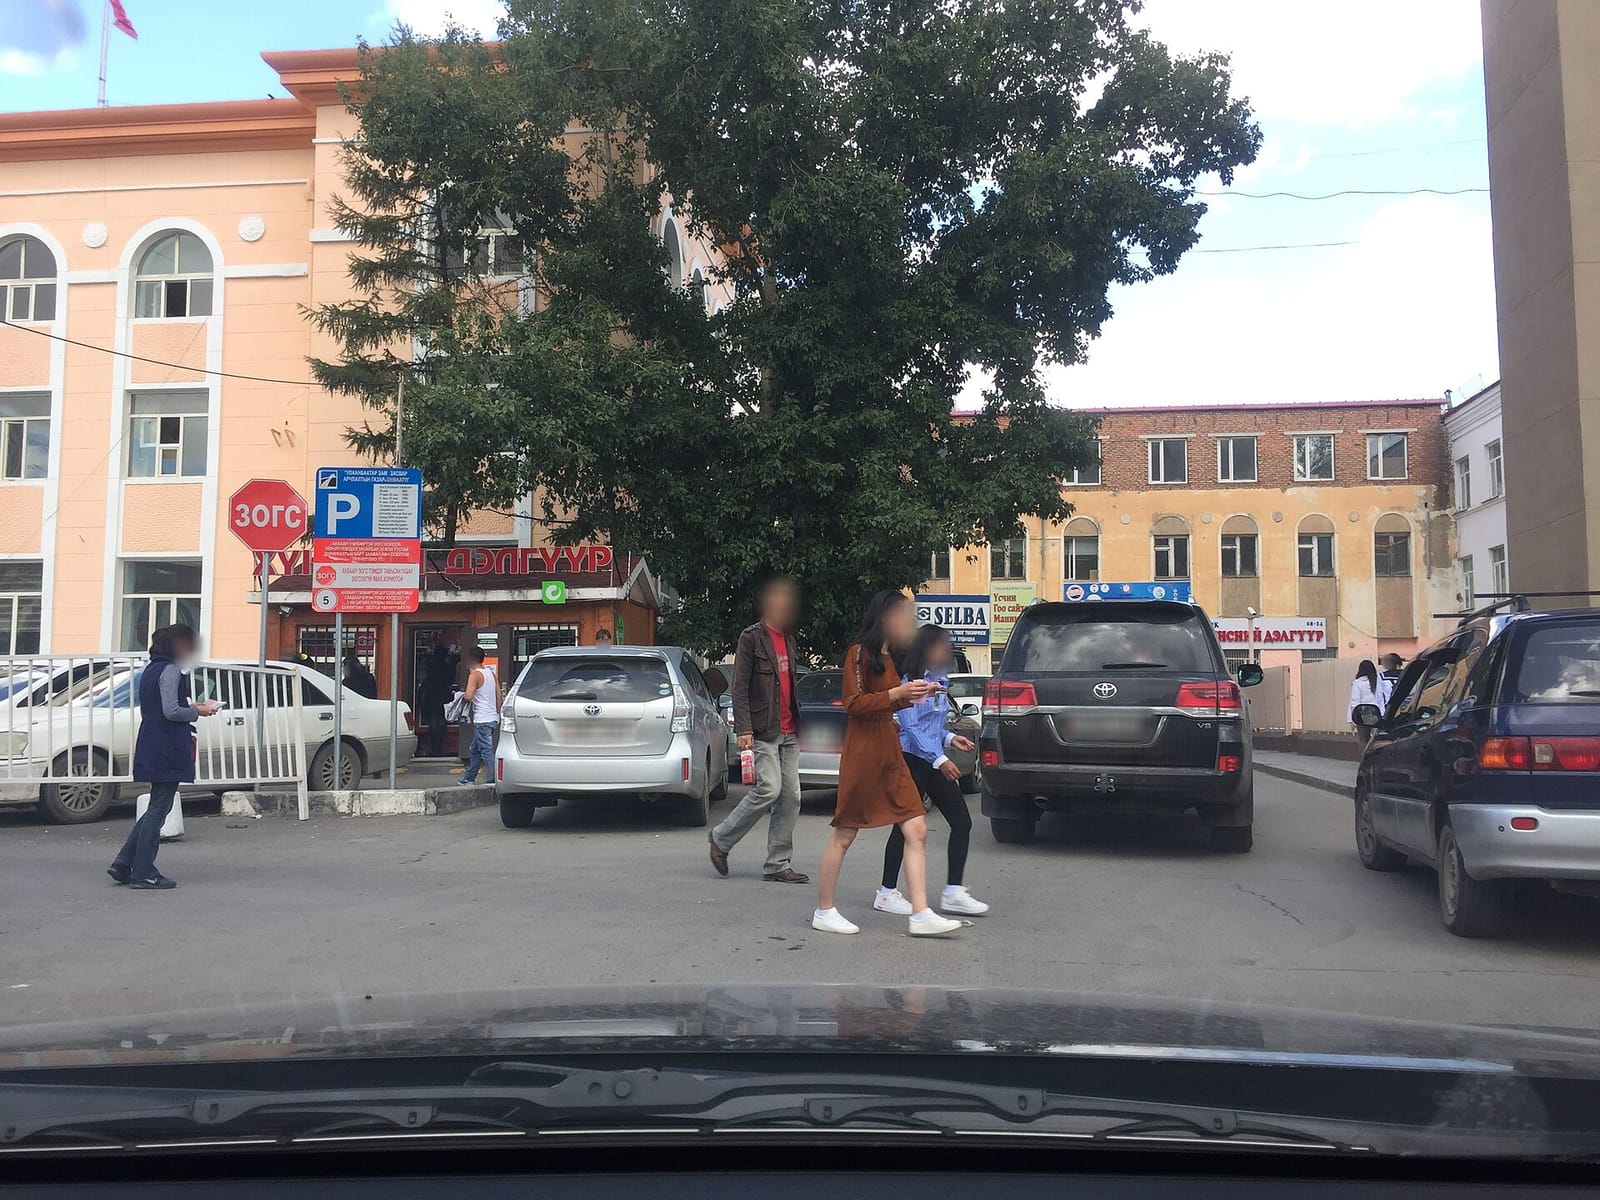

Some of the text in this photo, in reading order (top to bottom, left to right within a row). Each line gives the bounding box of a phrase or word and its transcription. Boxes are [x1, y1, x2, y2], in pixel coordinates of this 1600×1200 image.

[235, 503, 301, 528] ЗОГС
[327, 493, 361, 535] P
[445, 546, 613, 575] ДЭЛГҮҮР
[322, 596, 330, 605] 5
[993, 604, 1025, 613] Гоо сайх
[934, 606, 987, 626] SELBA
[1264, 630, 1324, 644] ДЭЛГҮҮР
[1197, 722, 1212, 730] V8
